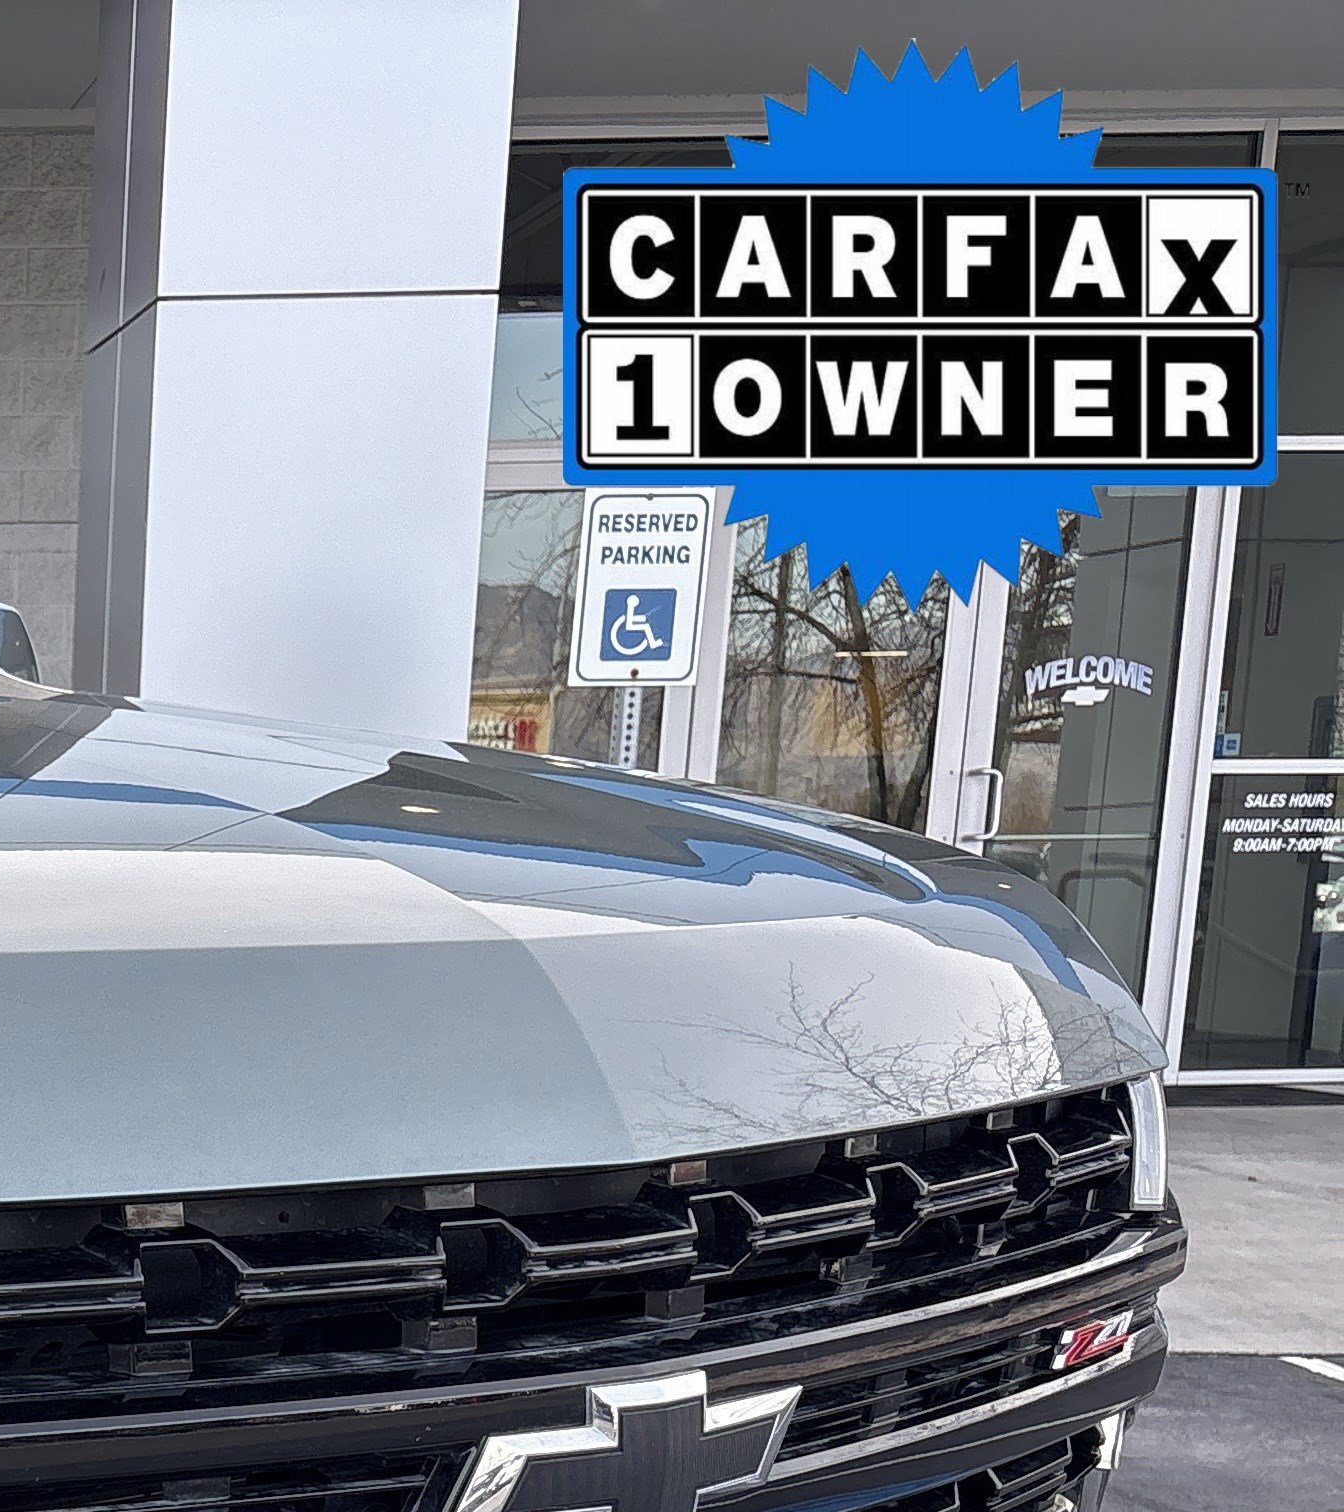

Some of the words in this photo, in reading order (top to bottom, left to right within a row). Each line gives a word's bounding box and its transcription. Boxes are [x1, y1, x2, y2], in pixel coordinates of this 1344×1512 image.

[598, 513, 699, 533] RESERVED
[600, 545, 691, 565] PARKING
[1024, 655, 1154, 696] WELCOME
[1244, 793, 1288, 809] SALES
[1288, 793, 1335, 808] HOURS
[1222, 818, 1344, 833] MONDAY-SATURDA
